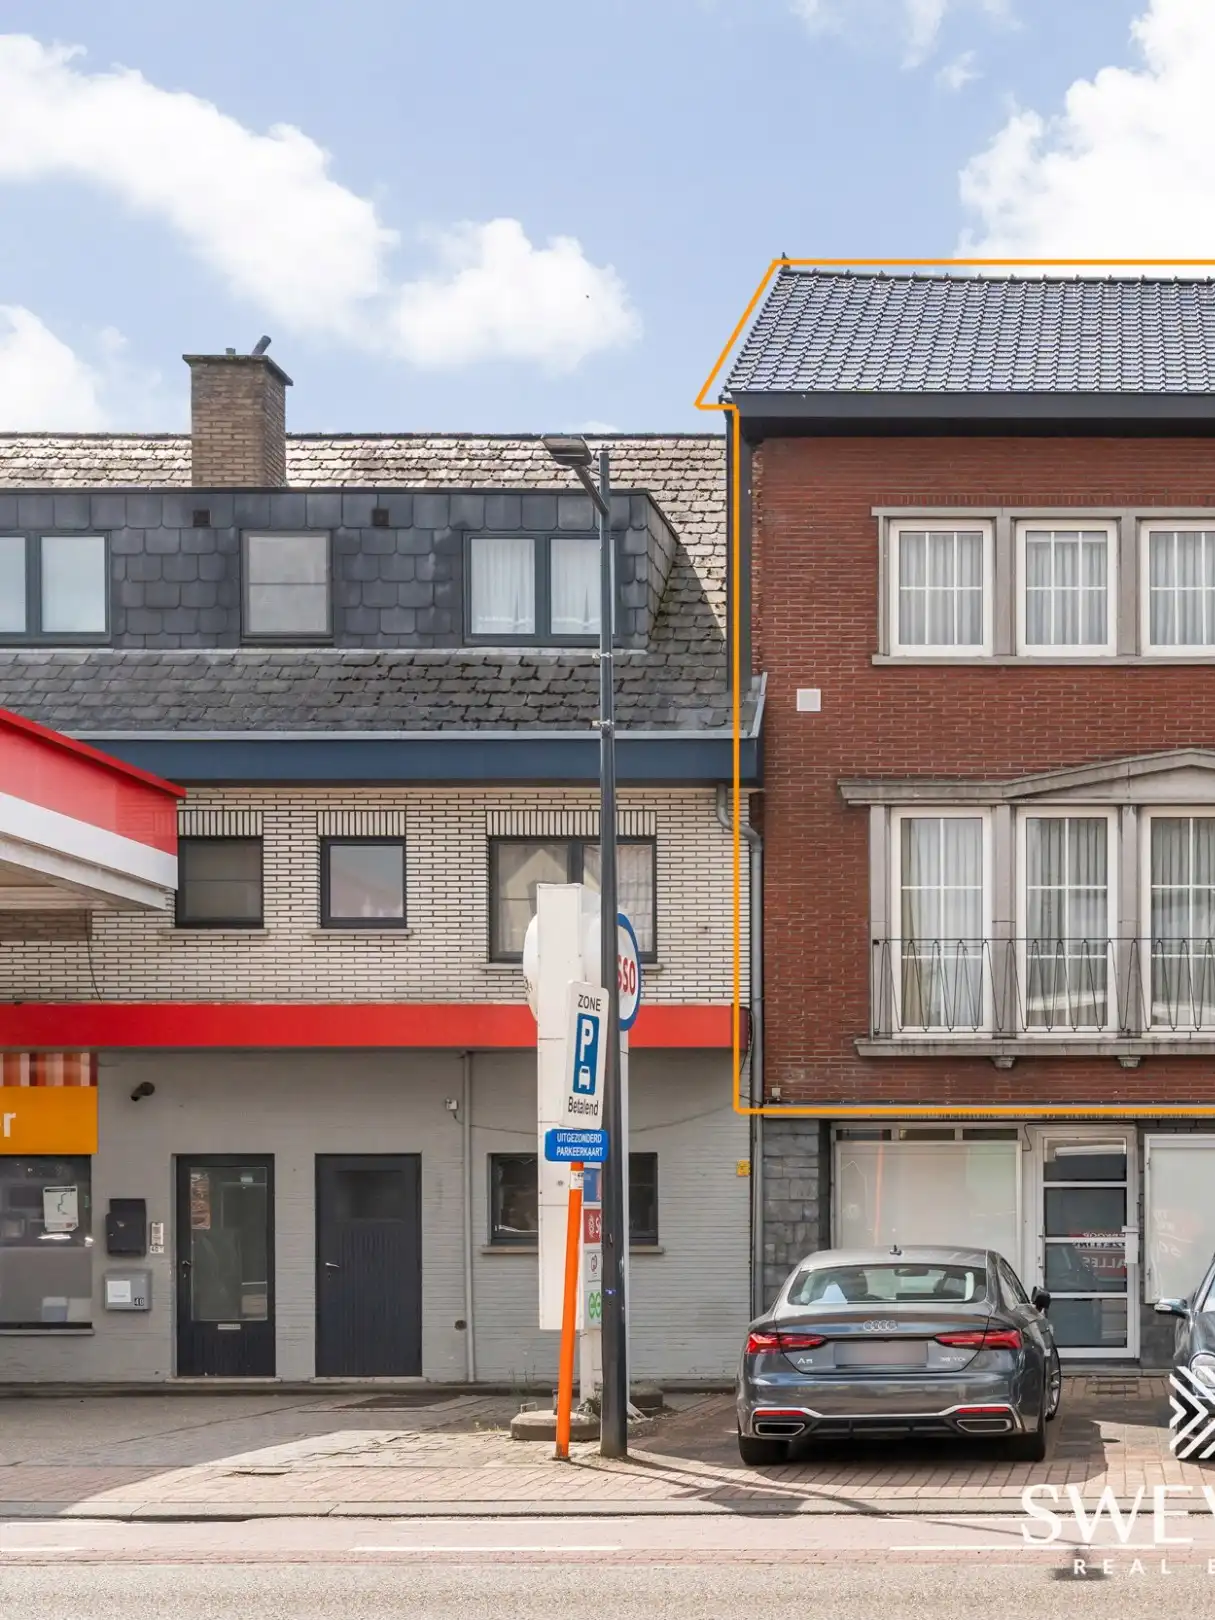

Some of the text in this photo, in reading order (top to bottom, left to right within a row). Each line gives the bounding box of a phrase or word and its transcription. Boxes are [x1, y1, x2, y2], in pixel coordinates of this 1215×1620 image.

[617, 954, 636, 996] SSO
[578, 994, 602, 1012] ZONE
[580, 1018, 594, 1062] P
[568, 1096, 599, 1116] Betalend
[3, 1112, 17, 1138] r
[556, 1132, 602, 1143] UITGEZONDERD
[556, 1146, 603, 1157] PARKEERKAART
